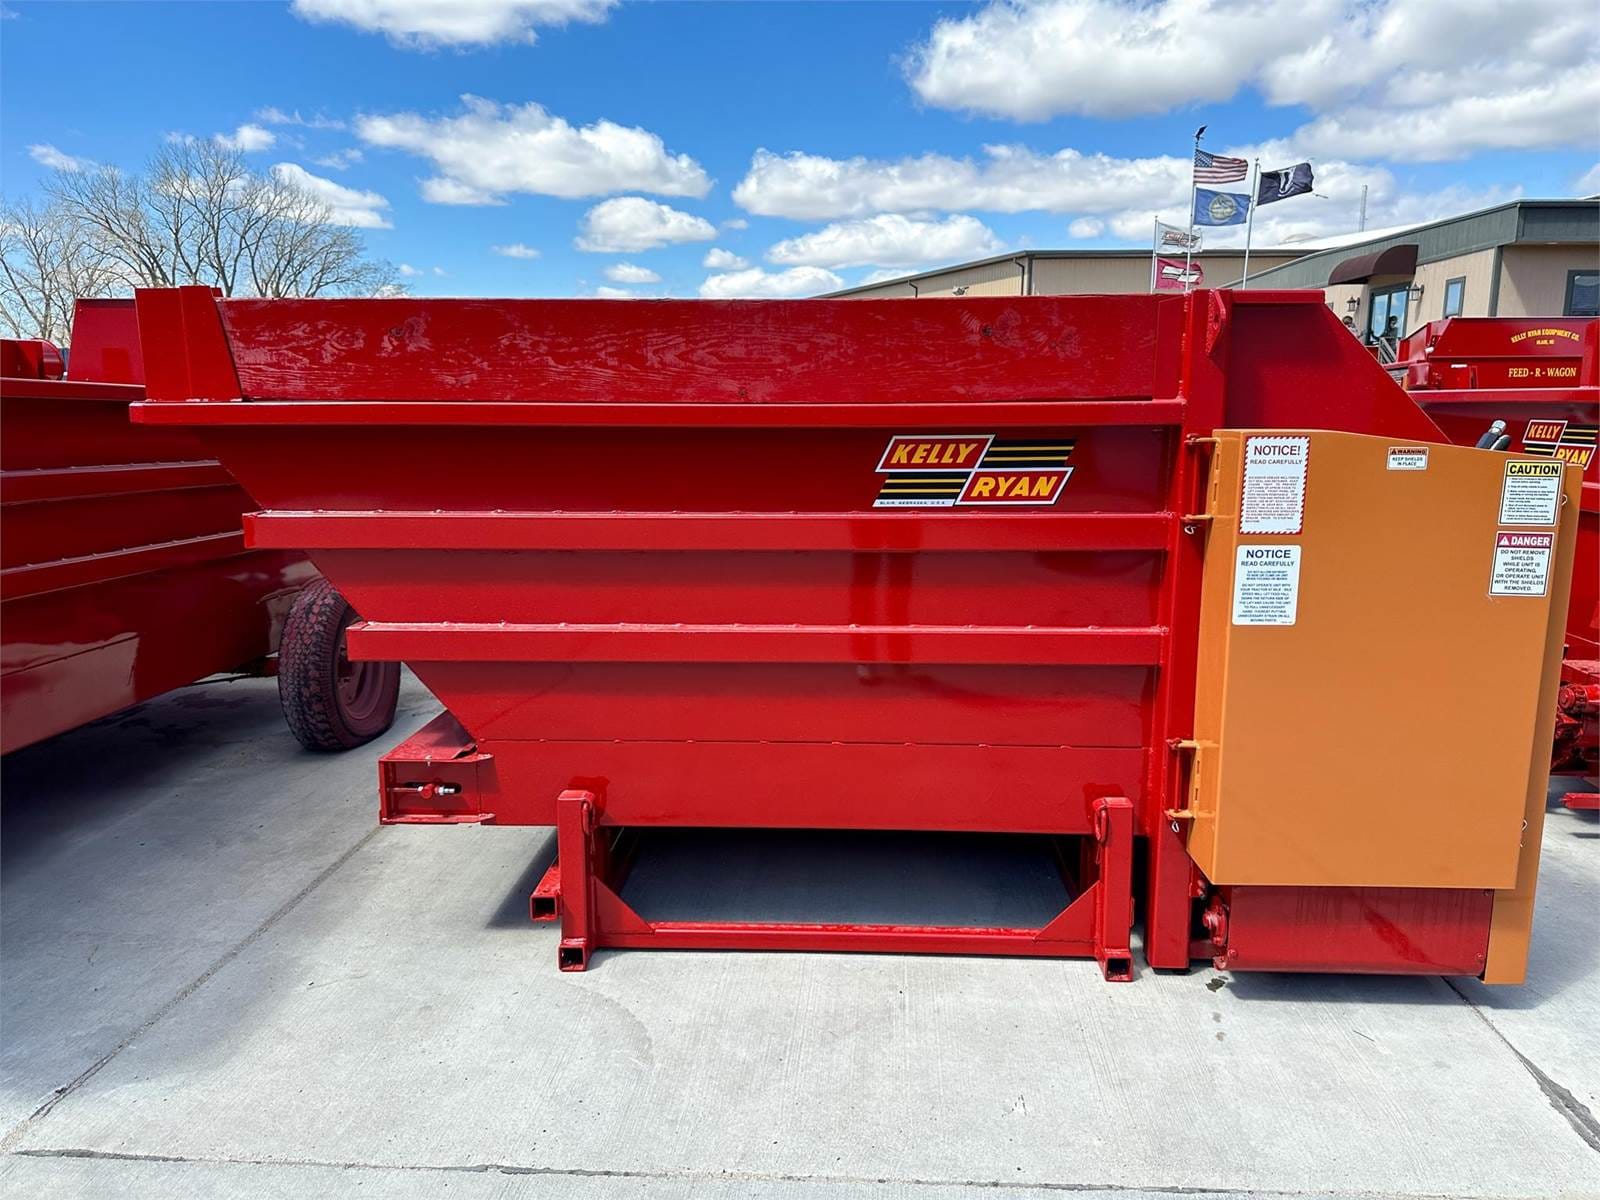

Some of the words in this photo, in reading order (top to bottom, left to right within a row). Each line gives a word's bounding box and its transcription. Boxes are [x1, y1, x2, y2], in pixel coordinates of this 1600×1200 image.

[1511, 332, 1526, 343] KELLY
[1528, 329, 1541, 337] RYAN
[1542, 328, 1571, 338] EQUIPMENT
[1508, 368, 1528, 377] FEED
[1535, 368, 1541, 377] R
[1547, 367, 1576, 377] WAGON
[1528, 424, 1561, 439] KELLY
[890, 443, 978, 464] KELLY
[1254, 445, 1300, 456] NOTICE!
[1556, 448, 1590, 464] RYAN
[1510, 464, 1559, 475] CAUTION
[970, 476, 1058, 497] RYAN
[1510, 536, 1550, 546] DANGER
[1246, 549, 1291, 559] NOTICE
